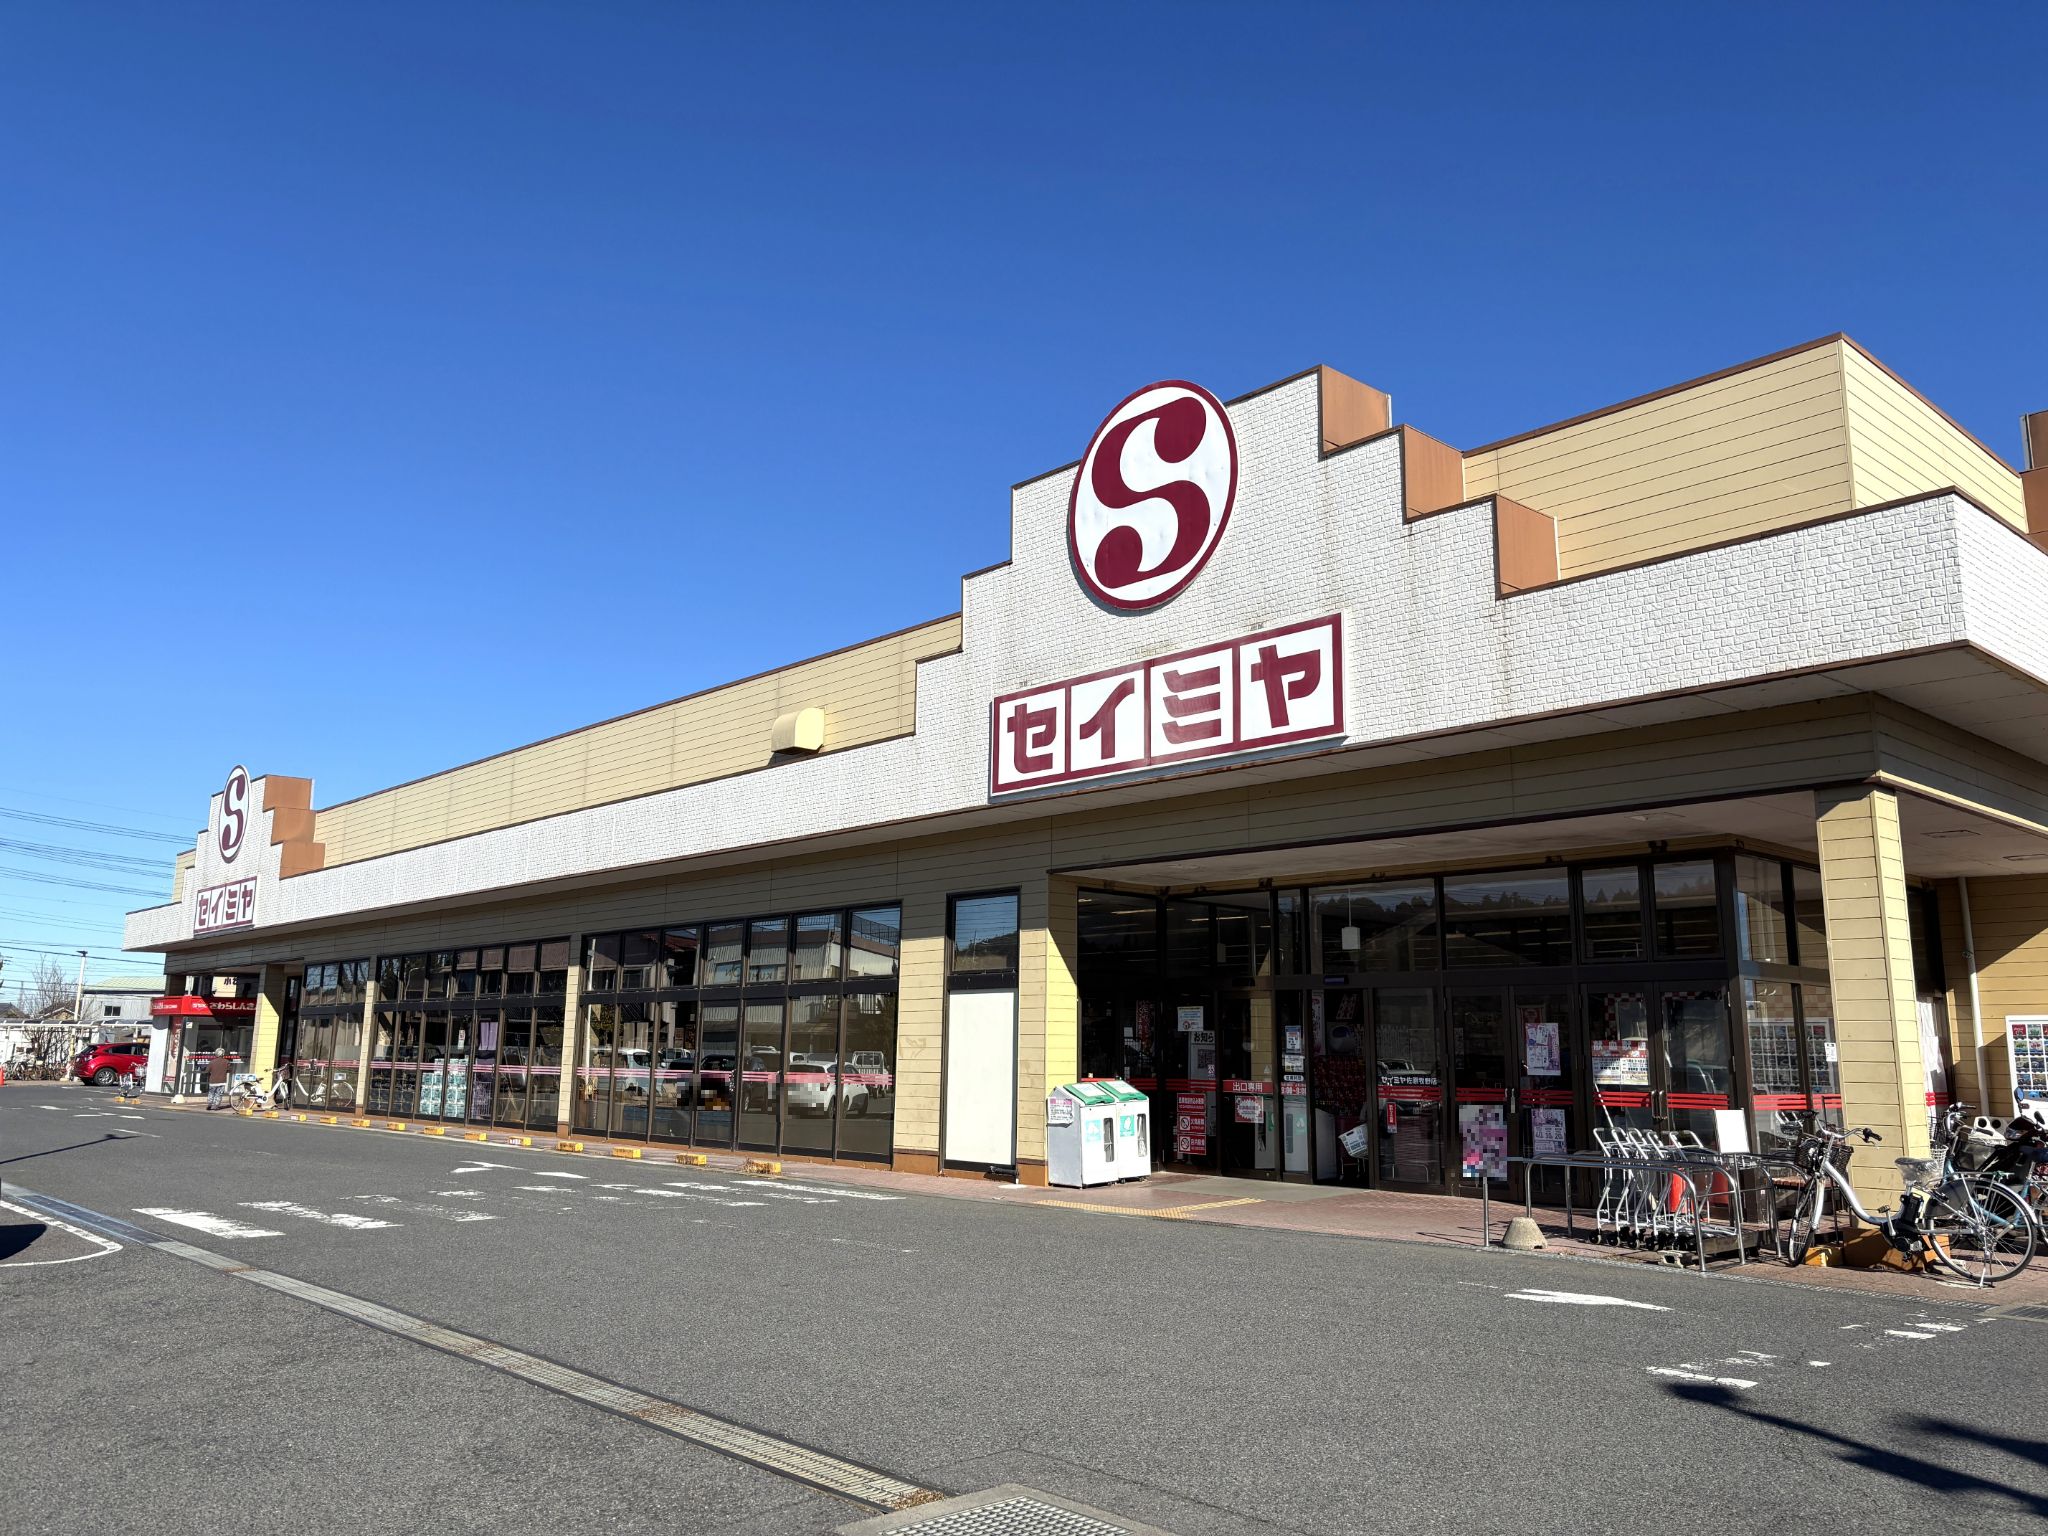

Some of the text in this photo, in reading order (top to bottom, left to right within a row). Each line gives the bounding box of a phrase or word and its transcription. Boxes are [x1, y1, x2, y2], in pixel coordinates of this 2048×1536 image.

[1088, 392, 1214, 594] S
[1007, 644, 1320, 773] セイミヤ
[222, 774, 245, 851] S
[198, 884, 253, 926] セイミヤ
[1232, 1082, 1263, 1093] 出口専用
